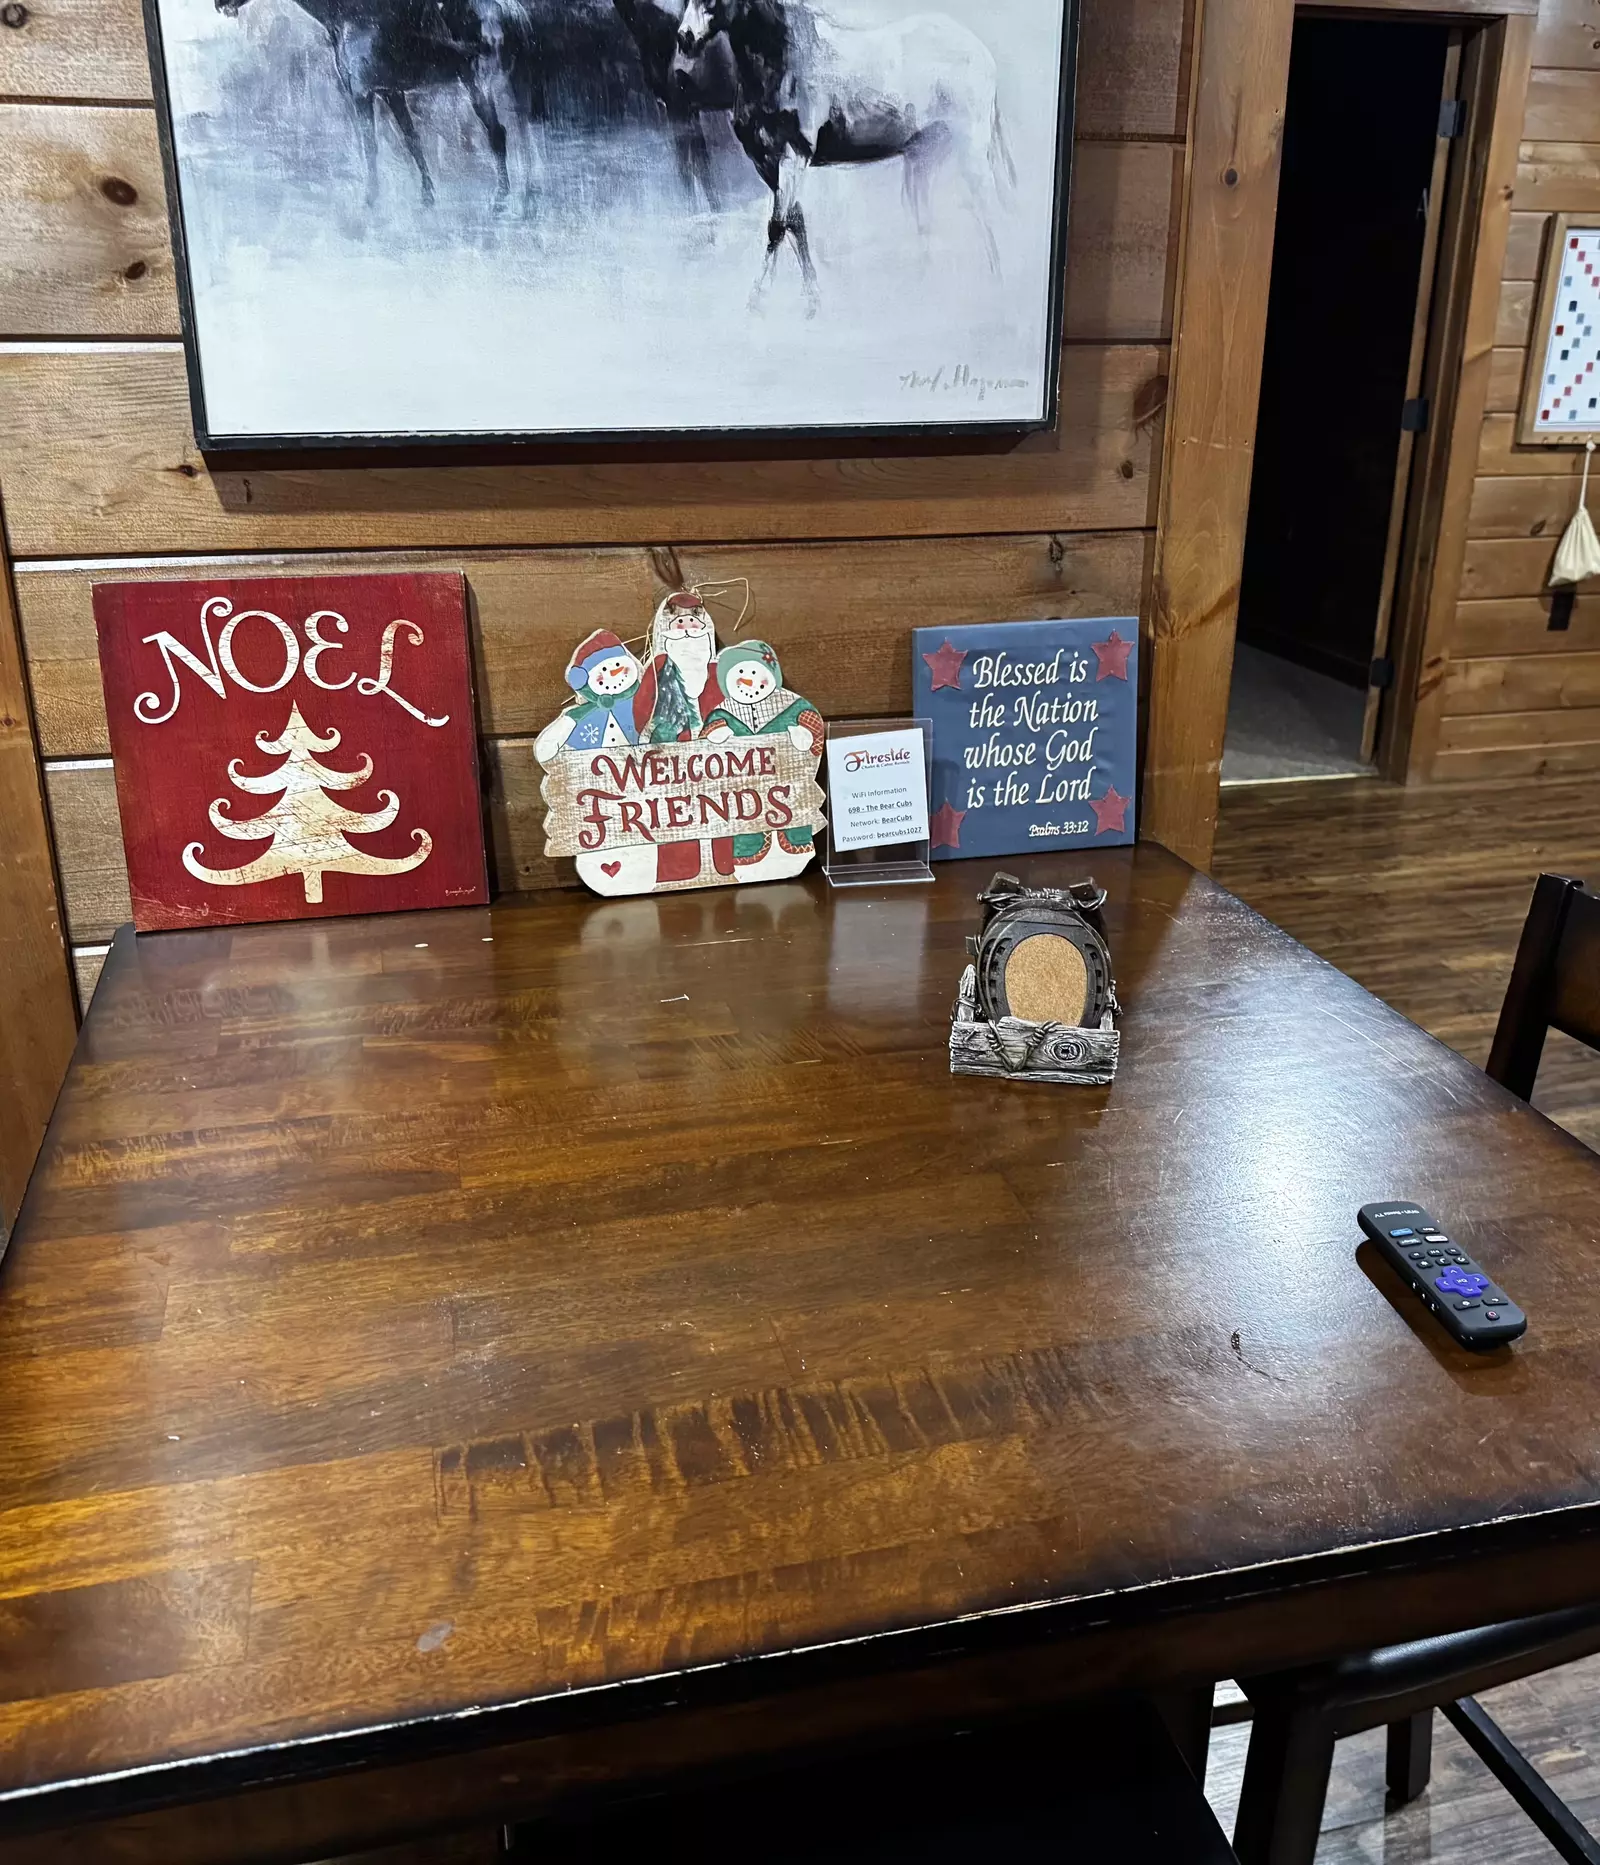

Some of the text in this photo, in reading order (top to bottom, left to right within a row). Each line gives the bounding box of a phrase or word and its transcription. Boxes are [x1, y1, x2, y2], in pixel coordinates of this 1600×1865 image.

[133, 596, 450, 728] NOEL
[972, 648, 1089, 689] Blessed is
[969, 690, 1099, 733] the Nation
[843, 748, 911, 772] Fireside
[963, 726, 1099, 771] whose God
[591, 747, 776, 792] WELCOME
[966, 765, 1097, 809] is the Lord
[848, 806, 861, 814] 698
[896, 800, 913, 808] Cubs
[851, 787, 907, 799] WiFi Information
[576, 785, 793, 849] FRIENDS
[842, 826, 922, 843] Password: bearcubs1027
[850, 815, 913, 827] Network: BearCubs
[1061, 820, 1089, 834] 33:12
